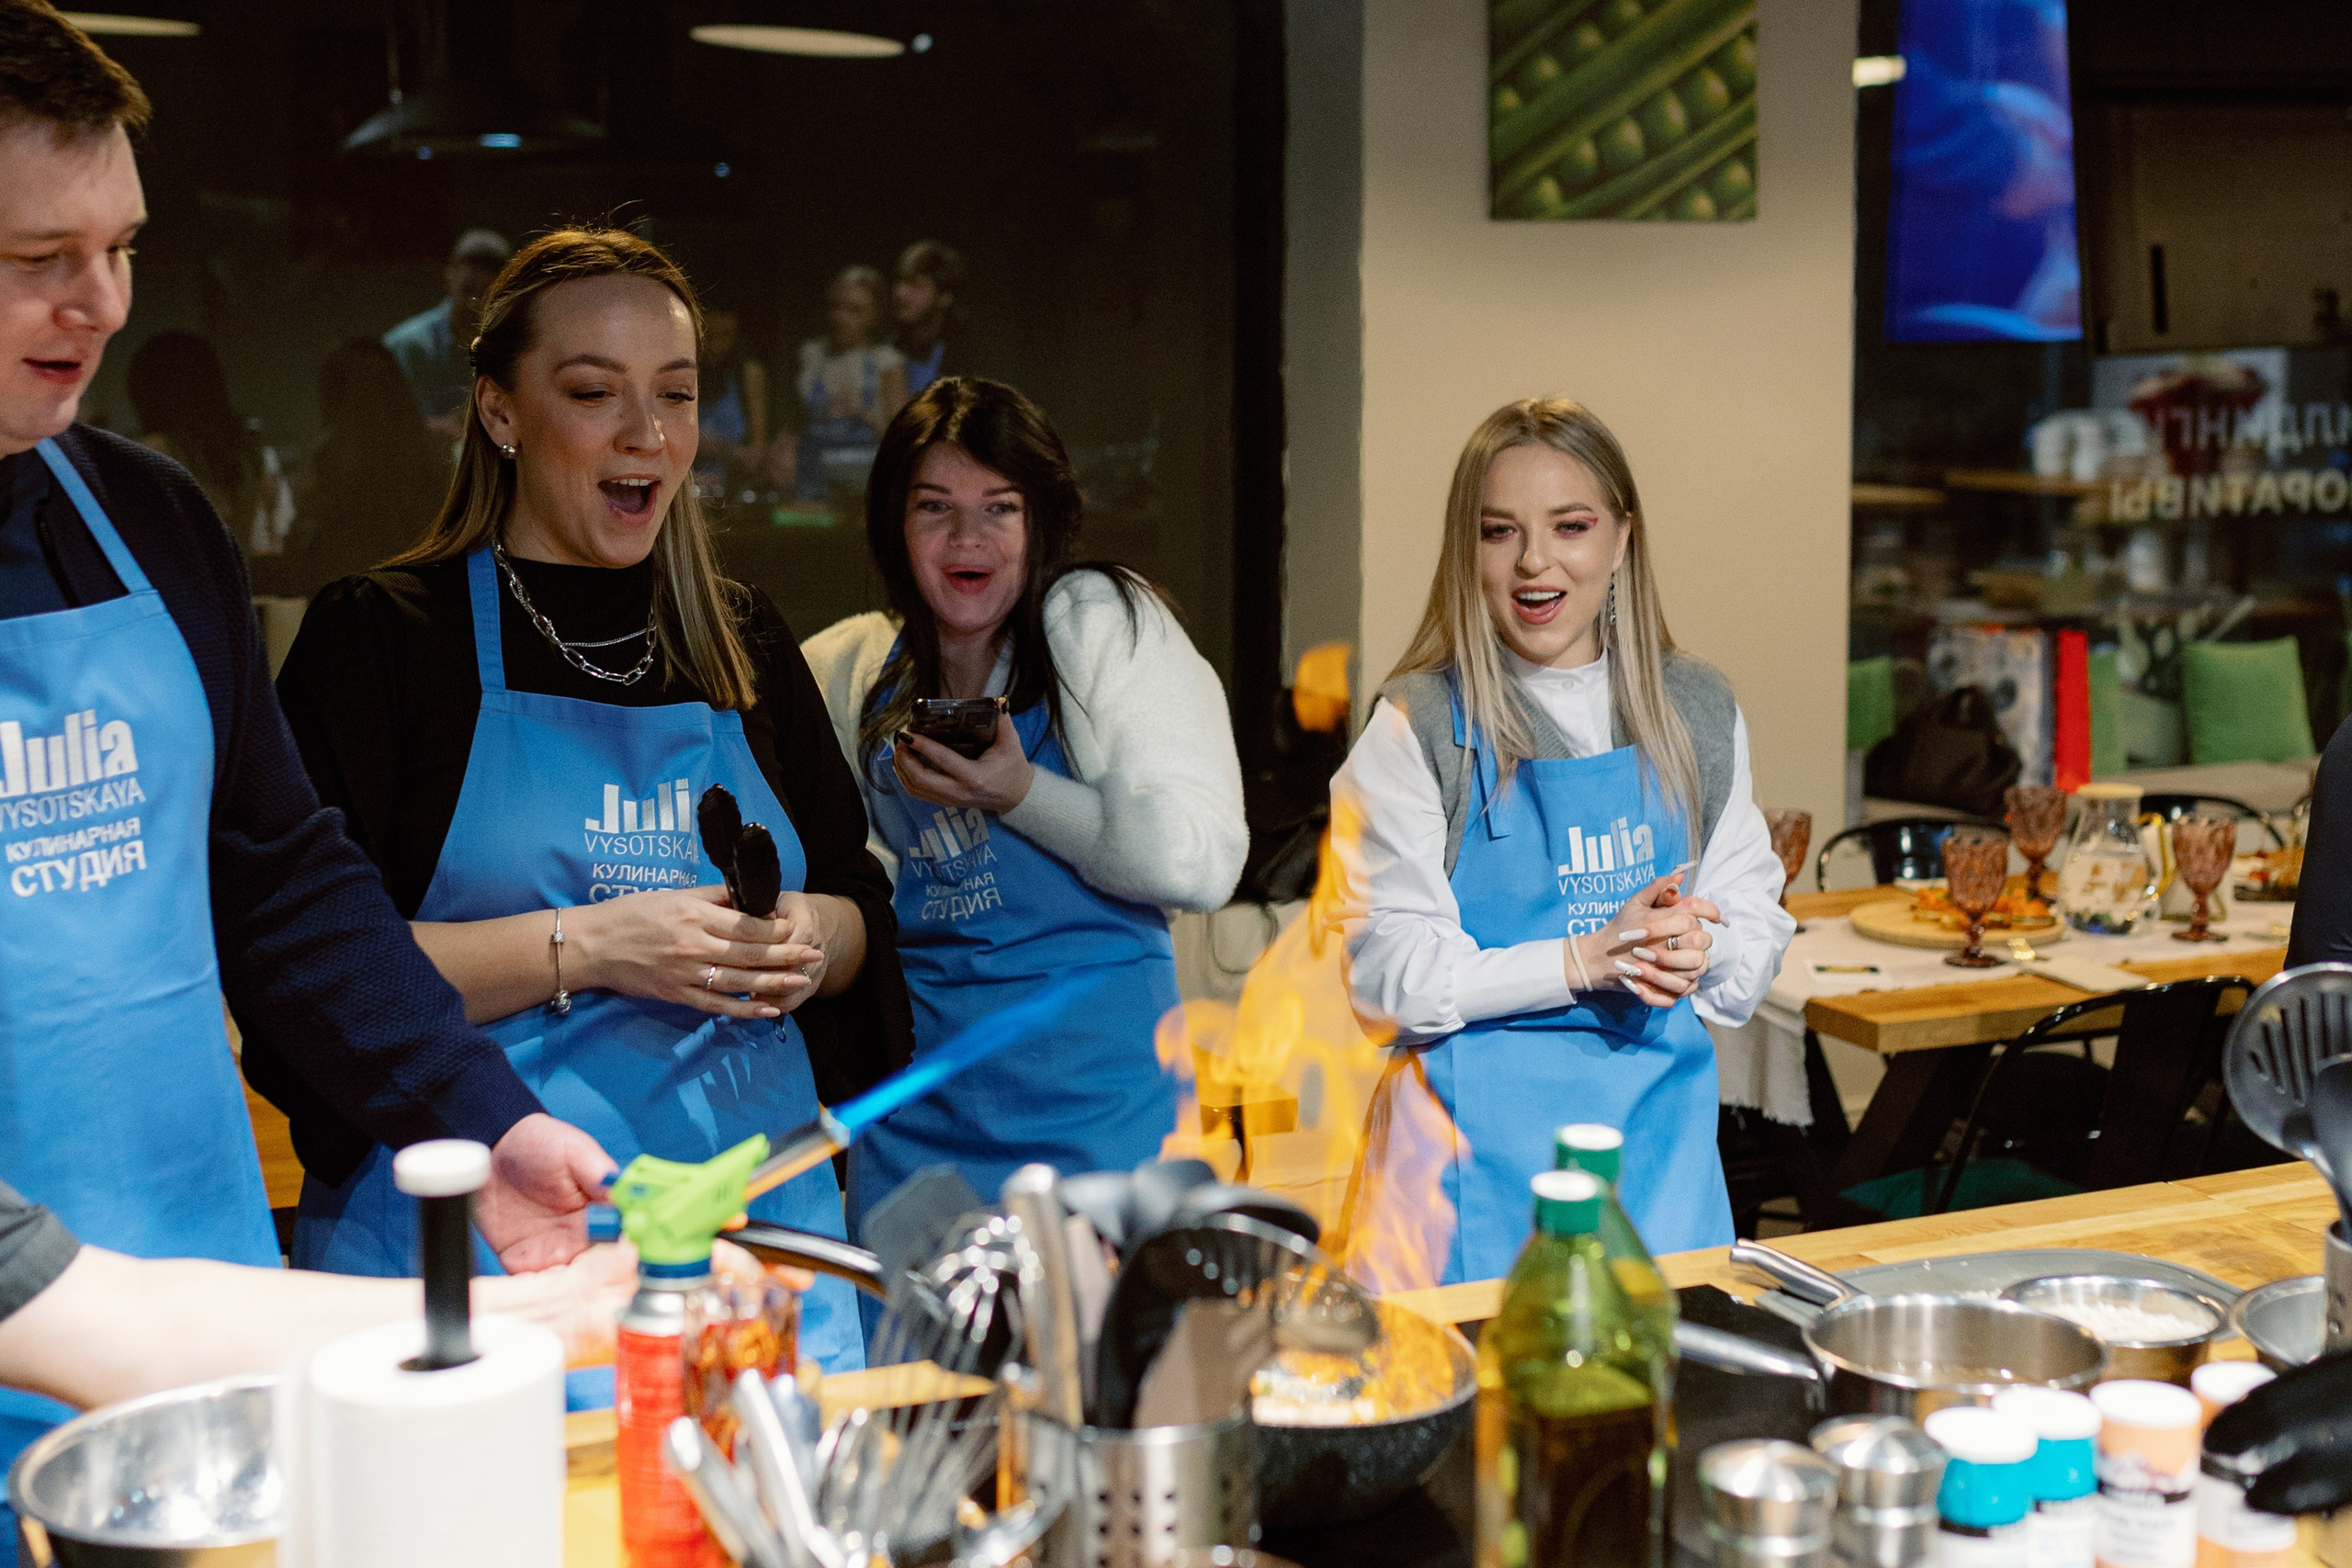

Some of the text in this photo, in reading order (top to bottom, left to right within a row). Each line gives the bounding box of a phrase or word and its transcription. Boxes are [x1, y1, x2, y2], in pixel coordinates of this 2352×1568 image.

[0, 709, 139, 797] Julia
[585, 778, 691, 833] Juli
[6, 817, 141, 863] КУЛИНАРНАЯ
[583, 832, 700, 864] VYSOTSKA
[1558, 817, 1655, 876] Julia
[10, 840, 147, 898] СТУДИЯ
[1558, 863, 1656, 896] VYSOTSKAYA
[922, 887, 1002, 921] СТУДИЯ
